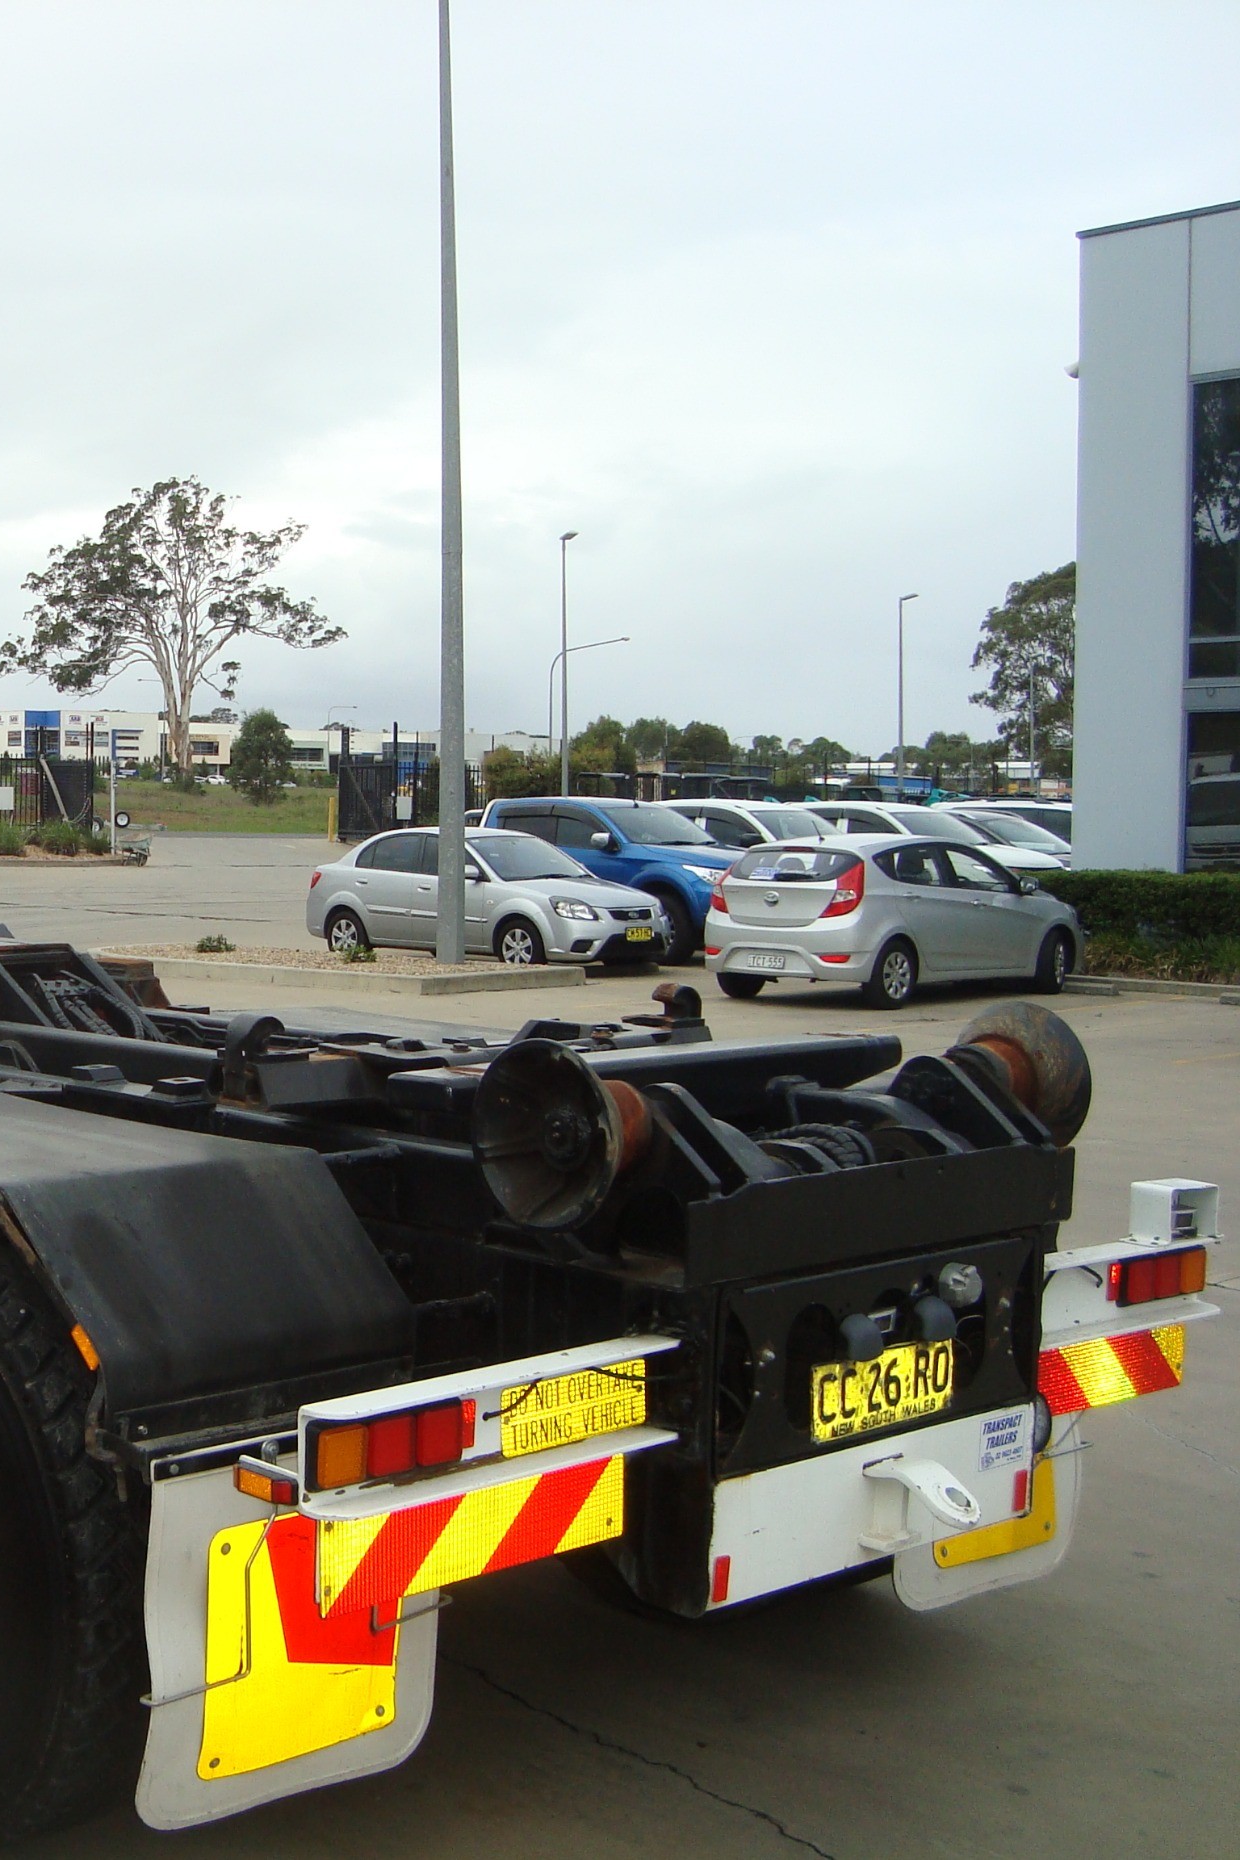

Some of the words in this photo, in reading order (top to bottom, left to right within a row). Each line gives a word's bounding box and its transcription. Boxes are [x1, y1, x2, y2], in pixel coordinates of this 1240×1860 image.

[510, 1389, 528, 1418] DO
[535, 1380, 560, 1411] NOT
[831, 1421, 855, 1438] NEW
[861, 1409, 896, 1430] SOUTH
[902, 1398, 936, 1418] WALES
[511, 1412, 572, 1451] TURNING
[581, 1395, 638, 1433] VEHICLE
[986, 1430, 1018, 1450] TRAILERS
